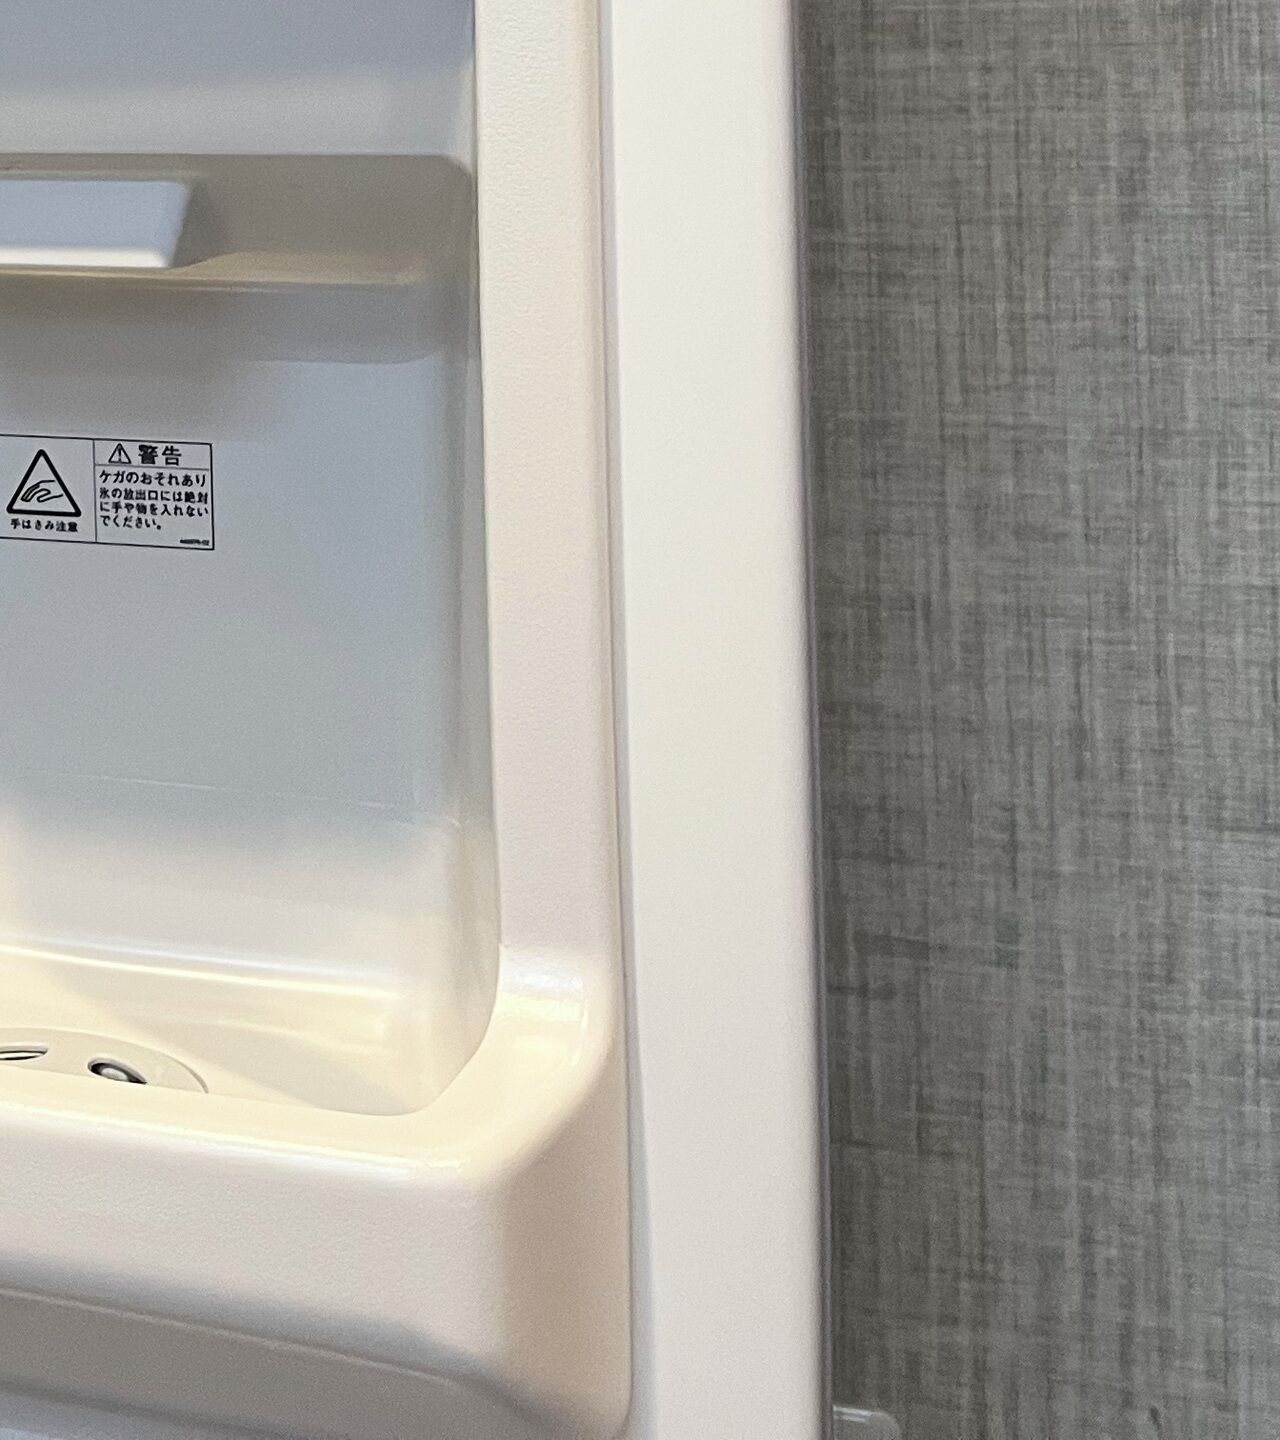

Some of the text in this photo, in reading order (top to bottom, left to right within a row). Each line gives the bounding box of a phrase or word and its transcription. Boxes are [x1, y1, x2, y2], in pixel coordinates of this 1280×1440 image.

[138, 444, 182, 466] 警告
[99, 470, 206, 487] ケガのおそれあり
[100, 487, 208, 504] 氷の放出口には絶対
[100, 501, 208, 517] に手や物を入れない
[100, 515, 161, 530] でください。
